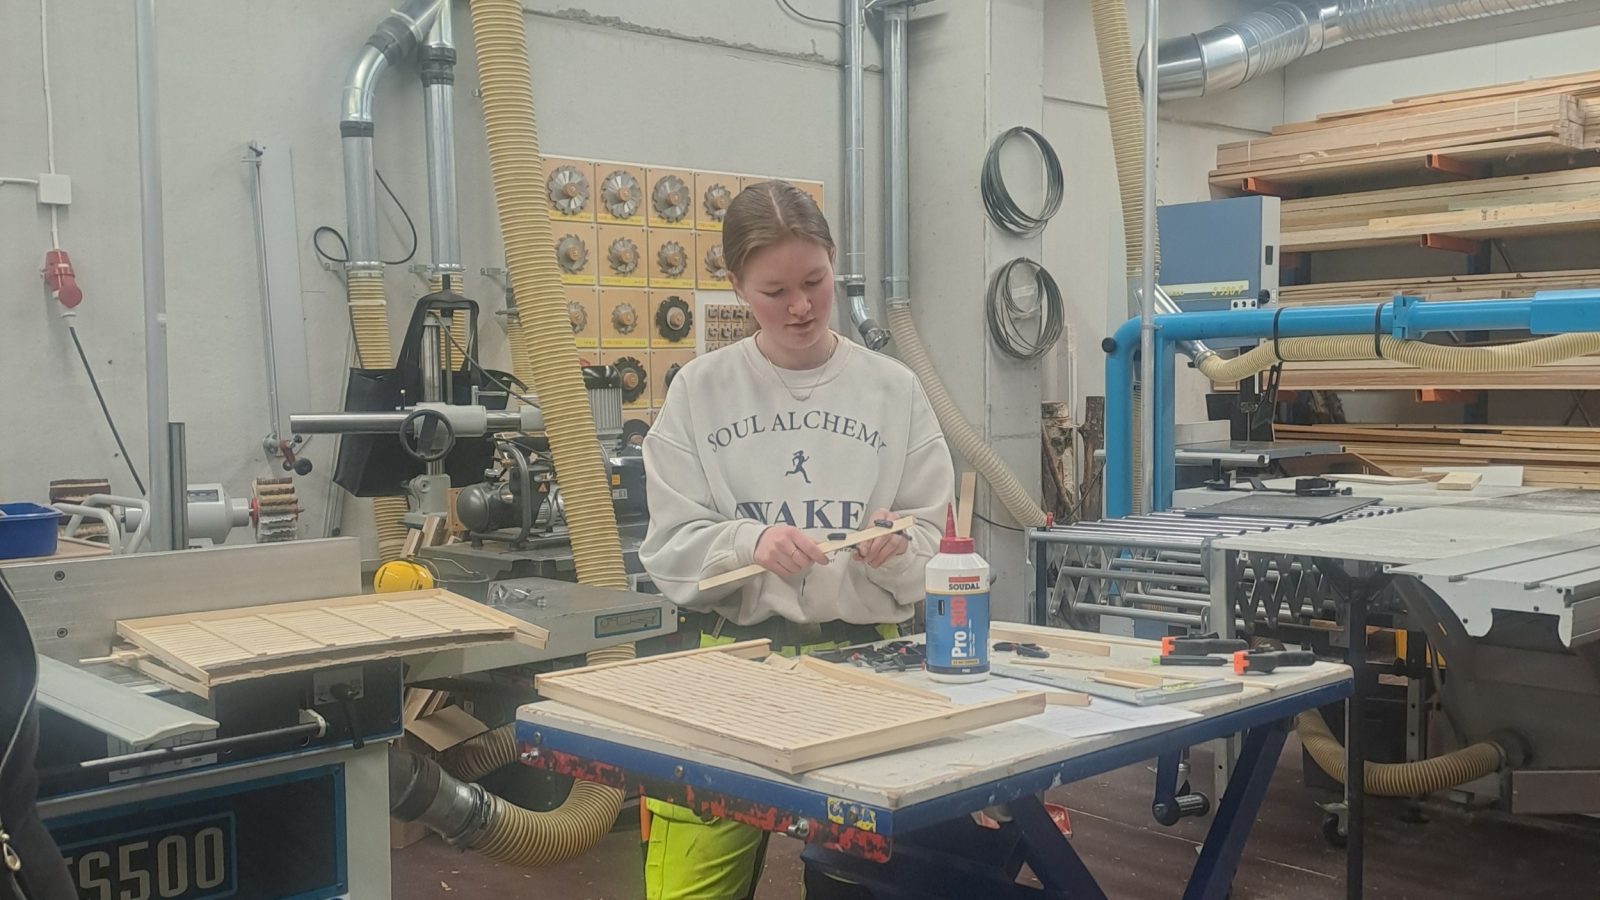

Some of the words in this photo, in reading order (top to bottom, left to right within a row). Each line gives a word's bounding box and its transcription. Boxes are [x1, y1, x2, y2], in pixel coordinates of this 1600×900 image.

[707, 415, 765, 452] SOUL
[771, 411, 887, 454] ALCHEMY
[951, 631, 967, 657] Pro
[64, 827, 225, 900] S500
